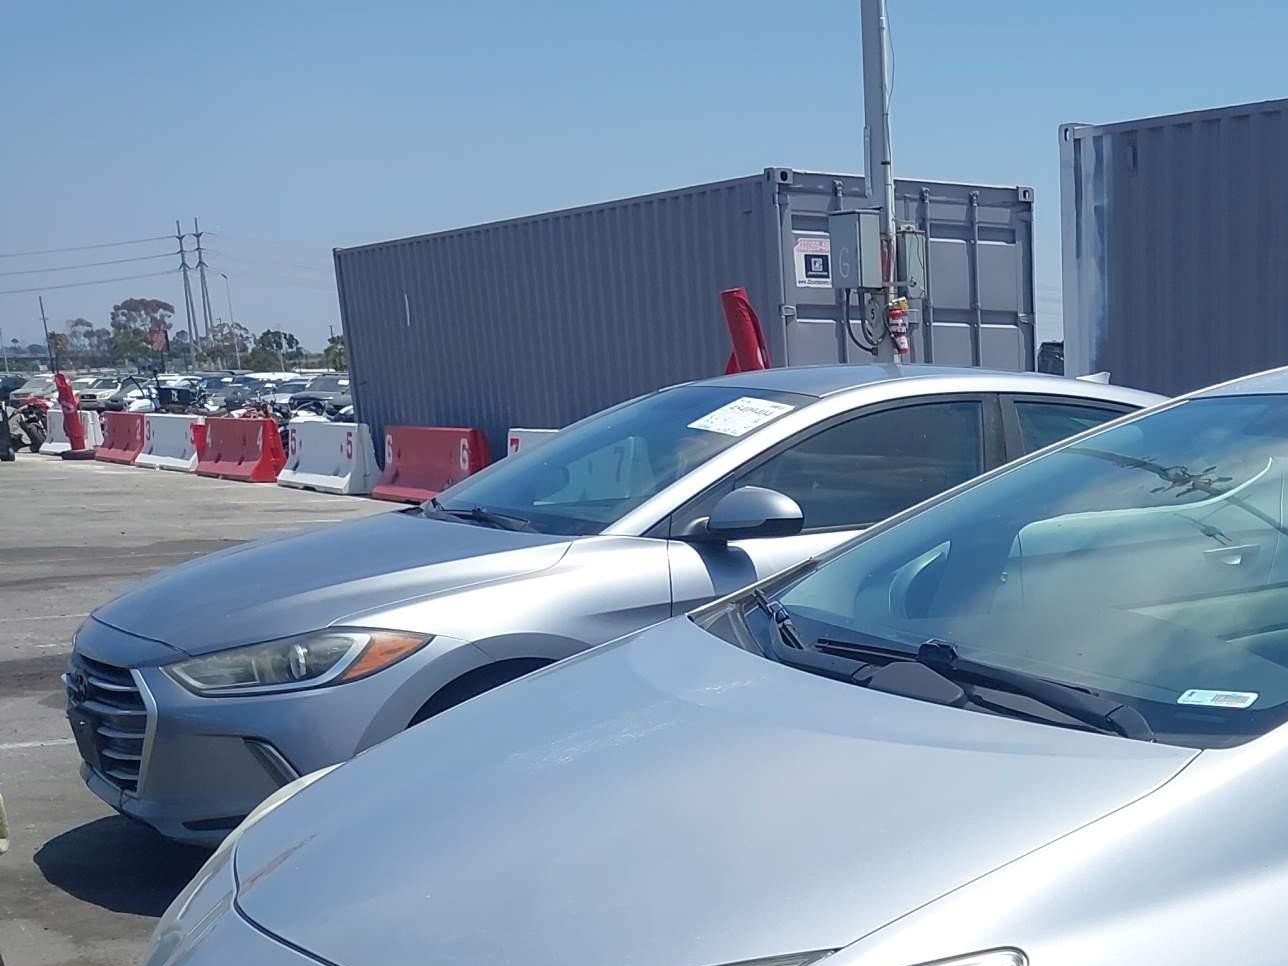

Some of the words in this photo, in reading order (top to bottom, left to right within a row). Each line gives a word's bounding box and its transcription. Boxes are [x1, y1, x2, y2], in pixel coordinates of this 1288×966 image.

[136, 418, 141, 440] 2
[146, 420, 151, 441] 3
[290, 429, 297, 455] 5
[346, 431, 353, 459] 5
[385, 434, 393, 464] 6
[459, 438, 469, 469] 6
